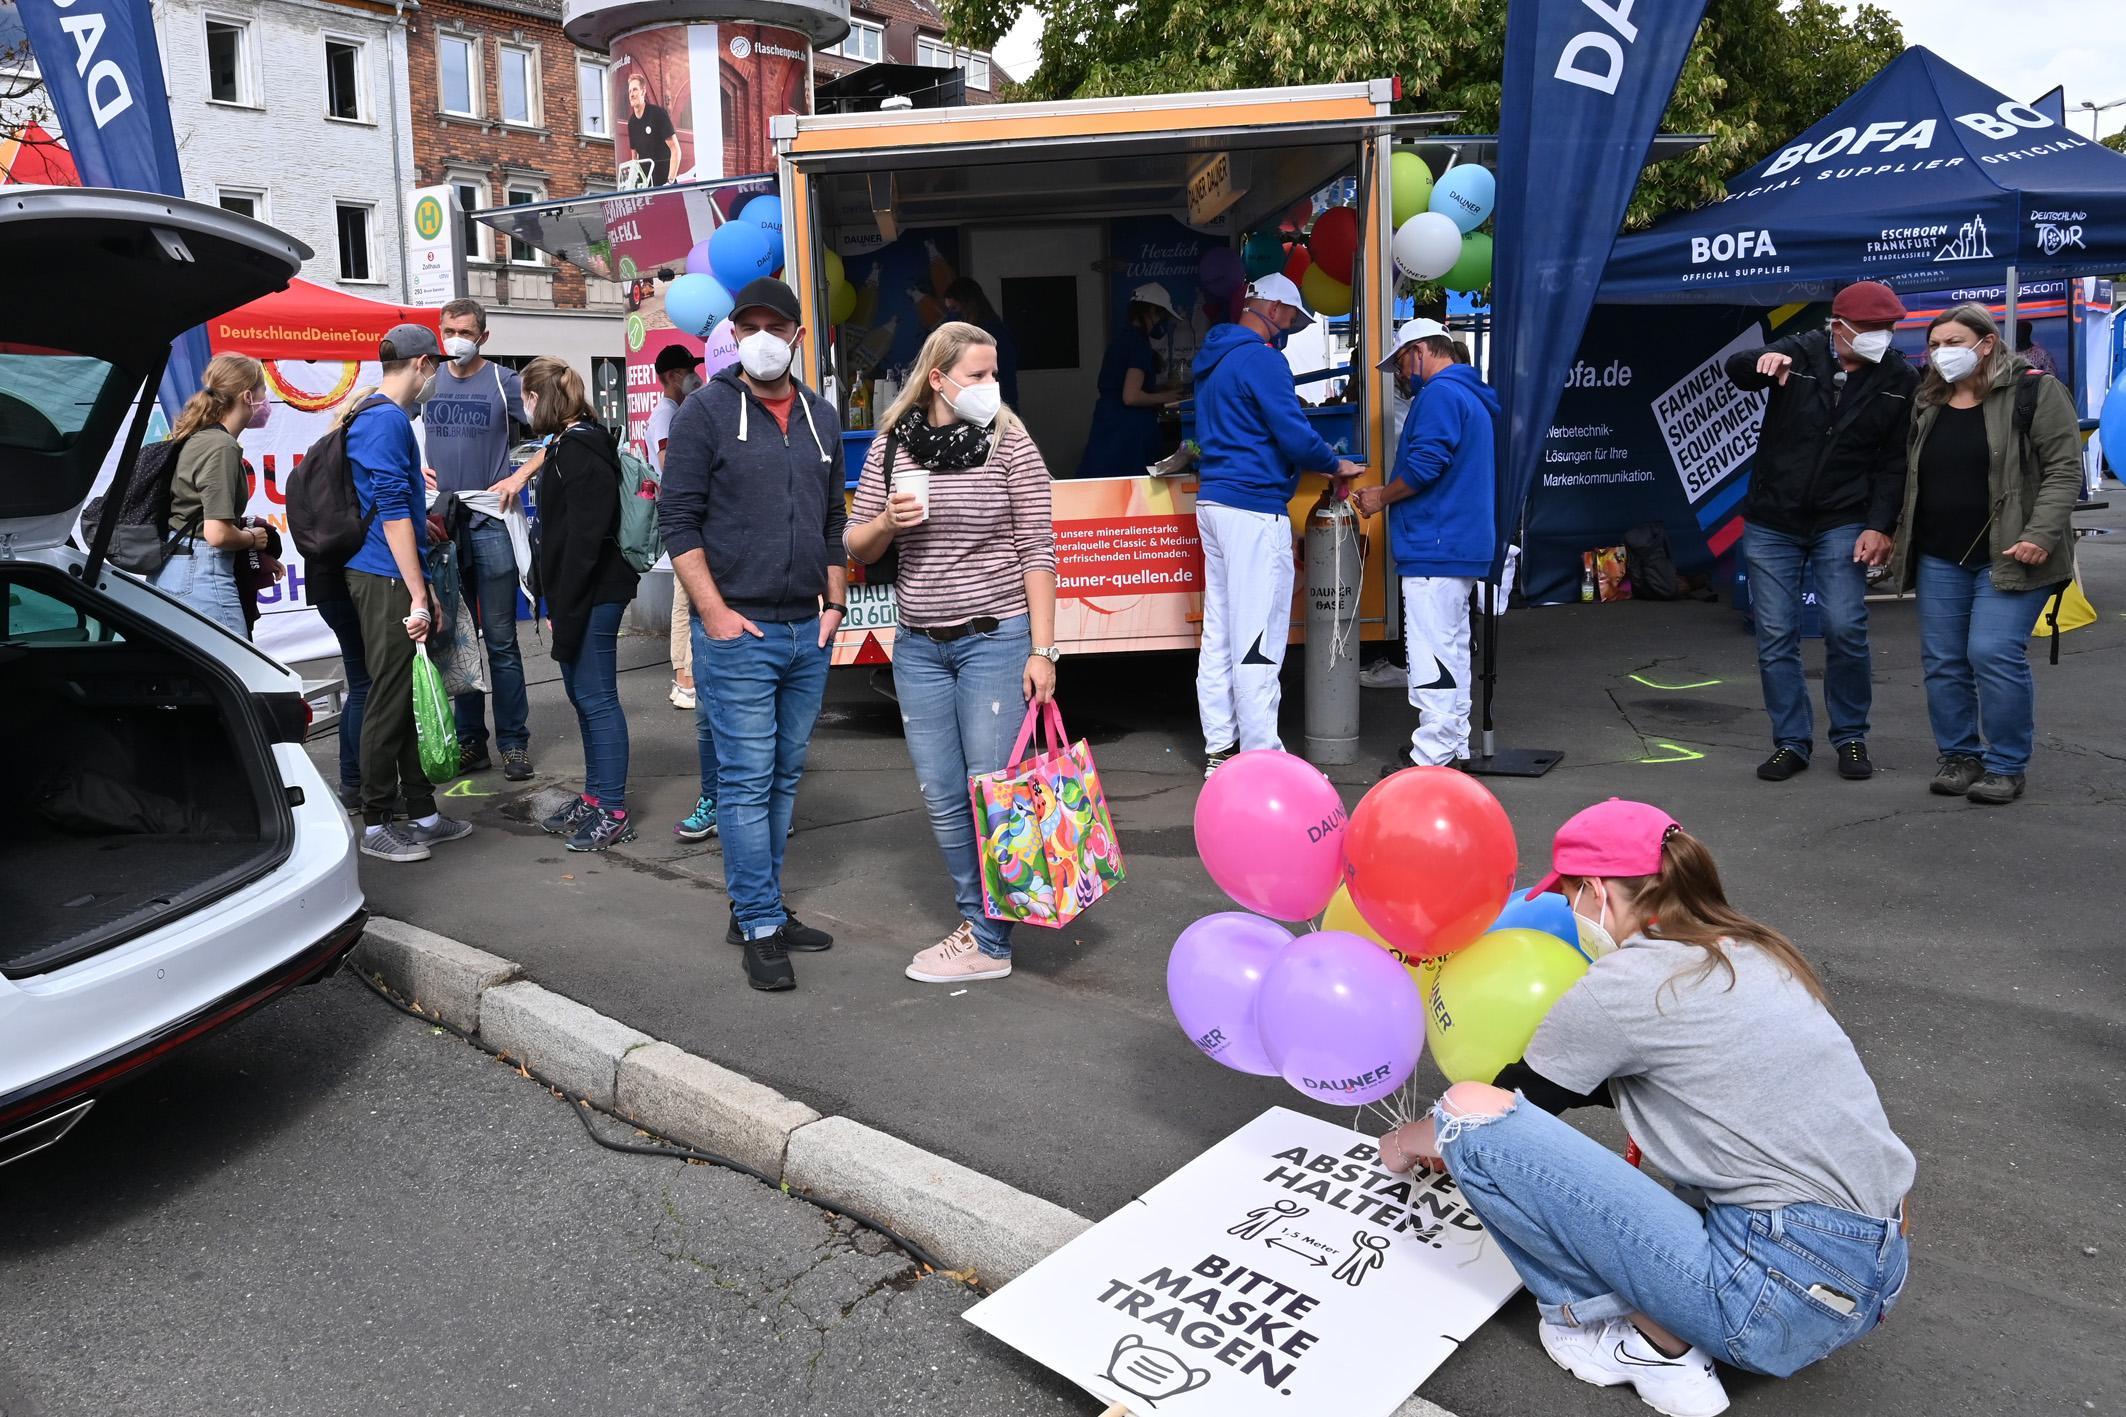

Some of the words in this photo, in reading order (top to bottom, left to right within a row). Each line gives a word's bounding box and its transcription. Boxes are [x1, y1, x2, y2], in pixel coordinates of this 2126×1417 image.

[755, 41, 806, 61] flaschenpost.de
[1554, 0, 1639, 96] DA
[58, 0, 133, 129] DA
[1954, 101, 2055, 140] BO
[1760, 118, 1937, 178] BOFA
[1981, 138, 2087, 164] OFFICIAL
[1696, 177, 1801, 208] FICIAL
[1817, 157, 1964, 180] SUPPLIER
[1449, 190, 1481, 214] DAUNER
[421, 206, 436, 230] H
[2030, 210, 2087, 221] DEUTSCHLAND
[844, 233, 882, 244] DAUNER
[1867, 237, 1937, 252] FRANKFURT
[1881, 225, 1948, 240] ESCHBORN
[1141, 240, 1199, 259] Herzlich
[1691, 229, 1777, 264] BOFA
[1879, 251, 1931, 261] RADKLASSIKER
[1395, 256, 1428, 280] DAUNER
[1682, 271, 1730, 282] OFFICIAL
[1735, 265, 1790, 277] SUPPLIER
[1951, 281, 2064, 300] champ-ys.com
[219, 324, 385, 343] DeutschlandDeineTour.
[1657, 359, 1723, 424] FAHNEN
[1667, 379, 1738, 448] SIGNAGE
[1677, 389, 1767, 471] EQUIPMENT
[1545, 449, 1592, 465] Lösungen
[1594, 447, 1608, 460] für
[1609, 447, 1628, 459] Ihre
[1686, 420, 1762, 494] SERVICES
[1543, 469, 1655, 487] Markenkommunikation.
[1060, 530, 1094, 539] unsere
[1096, 524, 1179, 537] mineralienstarke
[1113, 538, 1147, 548] Classic
[1149, 537, 1158, 546] &
[1063, 552, 1131, 564] erfrischenden
[1133, 549, 1190, 561] Limonaden.
[849, 584, 889, 604] DAU
[1310, 586, 1352, 597] DAUNER
[1316, 600, 1345, 610] GASE
[1302, 1064, 1391, 1091] DAUNER
[1271, 1146, 1485, 1232] ABSTAND
[1262, 1166, 1443, 1249] HALTEN.
[1281, 1227, 1301, 1239] 1,5
[1302, 1235, 1340, 1255] Meter
[1191, 1254, 1321, 1321] BITTE
[1137, 1266, 1320, 1359] MASKE
[1096, 1278, 1297, 1396] TRAGEN.
